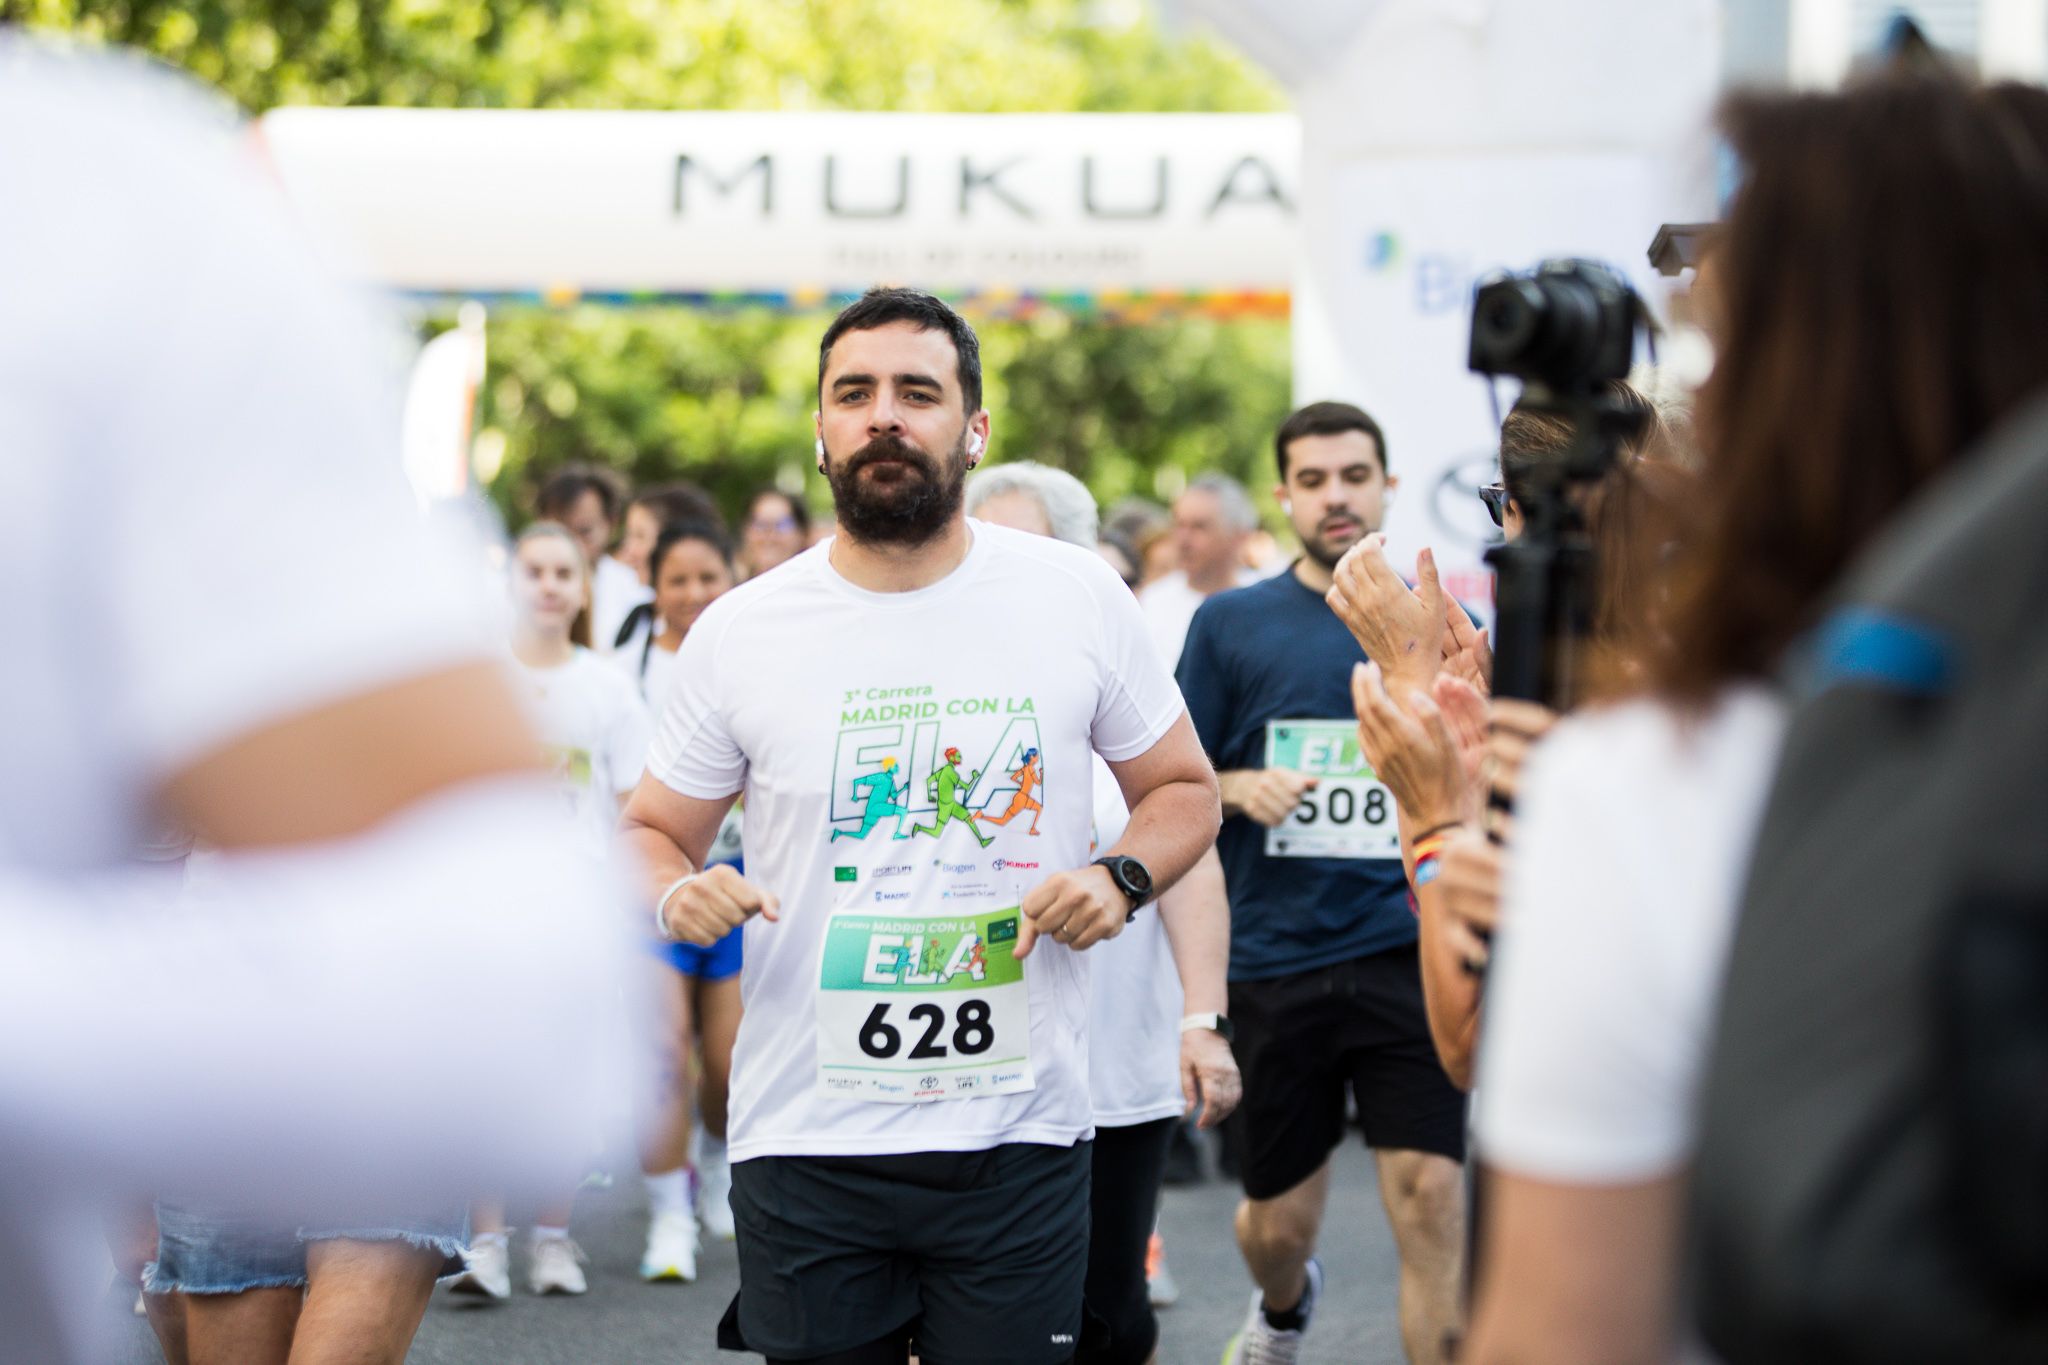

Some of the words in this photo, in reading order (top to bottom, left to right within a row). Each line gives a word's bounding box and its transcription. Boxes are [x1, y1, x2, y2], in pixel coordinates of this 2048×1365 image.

[671, 153, 1296, 218] MUKUA
[839, 701, 940, 727] MADRID
[945, 698, 999, 716] CON
[1006, 697, 1036, 713] LA
[866, 685, 933, 701] Carrera
[829, 717, 1044, 823] ELA
[1295, 787, 1387, 826] 508
[871, 920, 926, 934] MADRID
[927, 921, 957, 933] CON
[960, 920, 977, 932] LA
[862, 933, 987, 985] ELA
[858, 998, 995, 1060] 628
